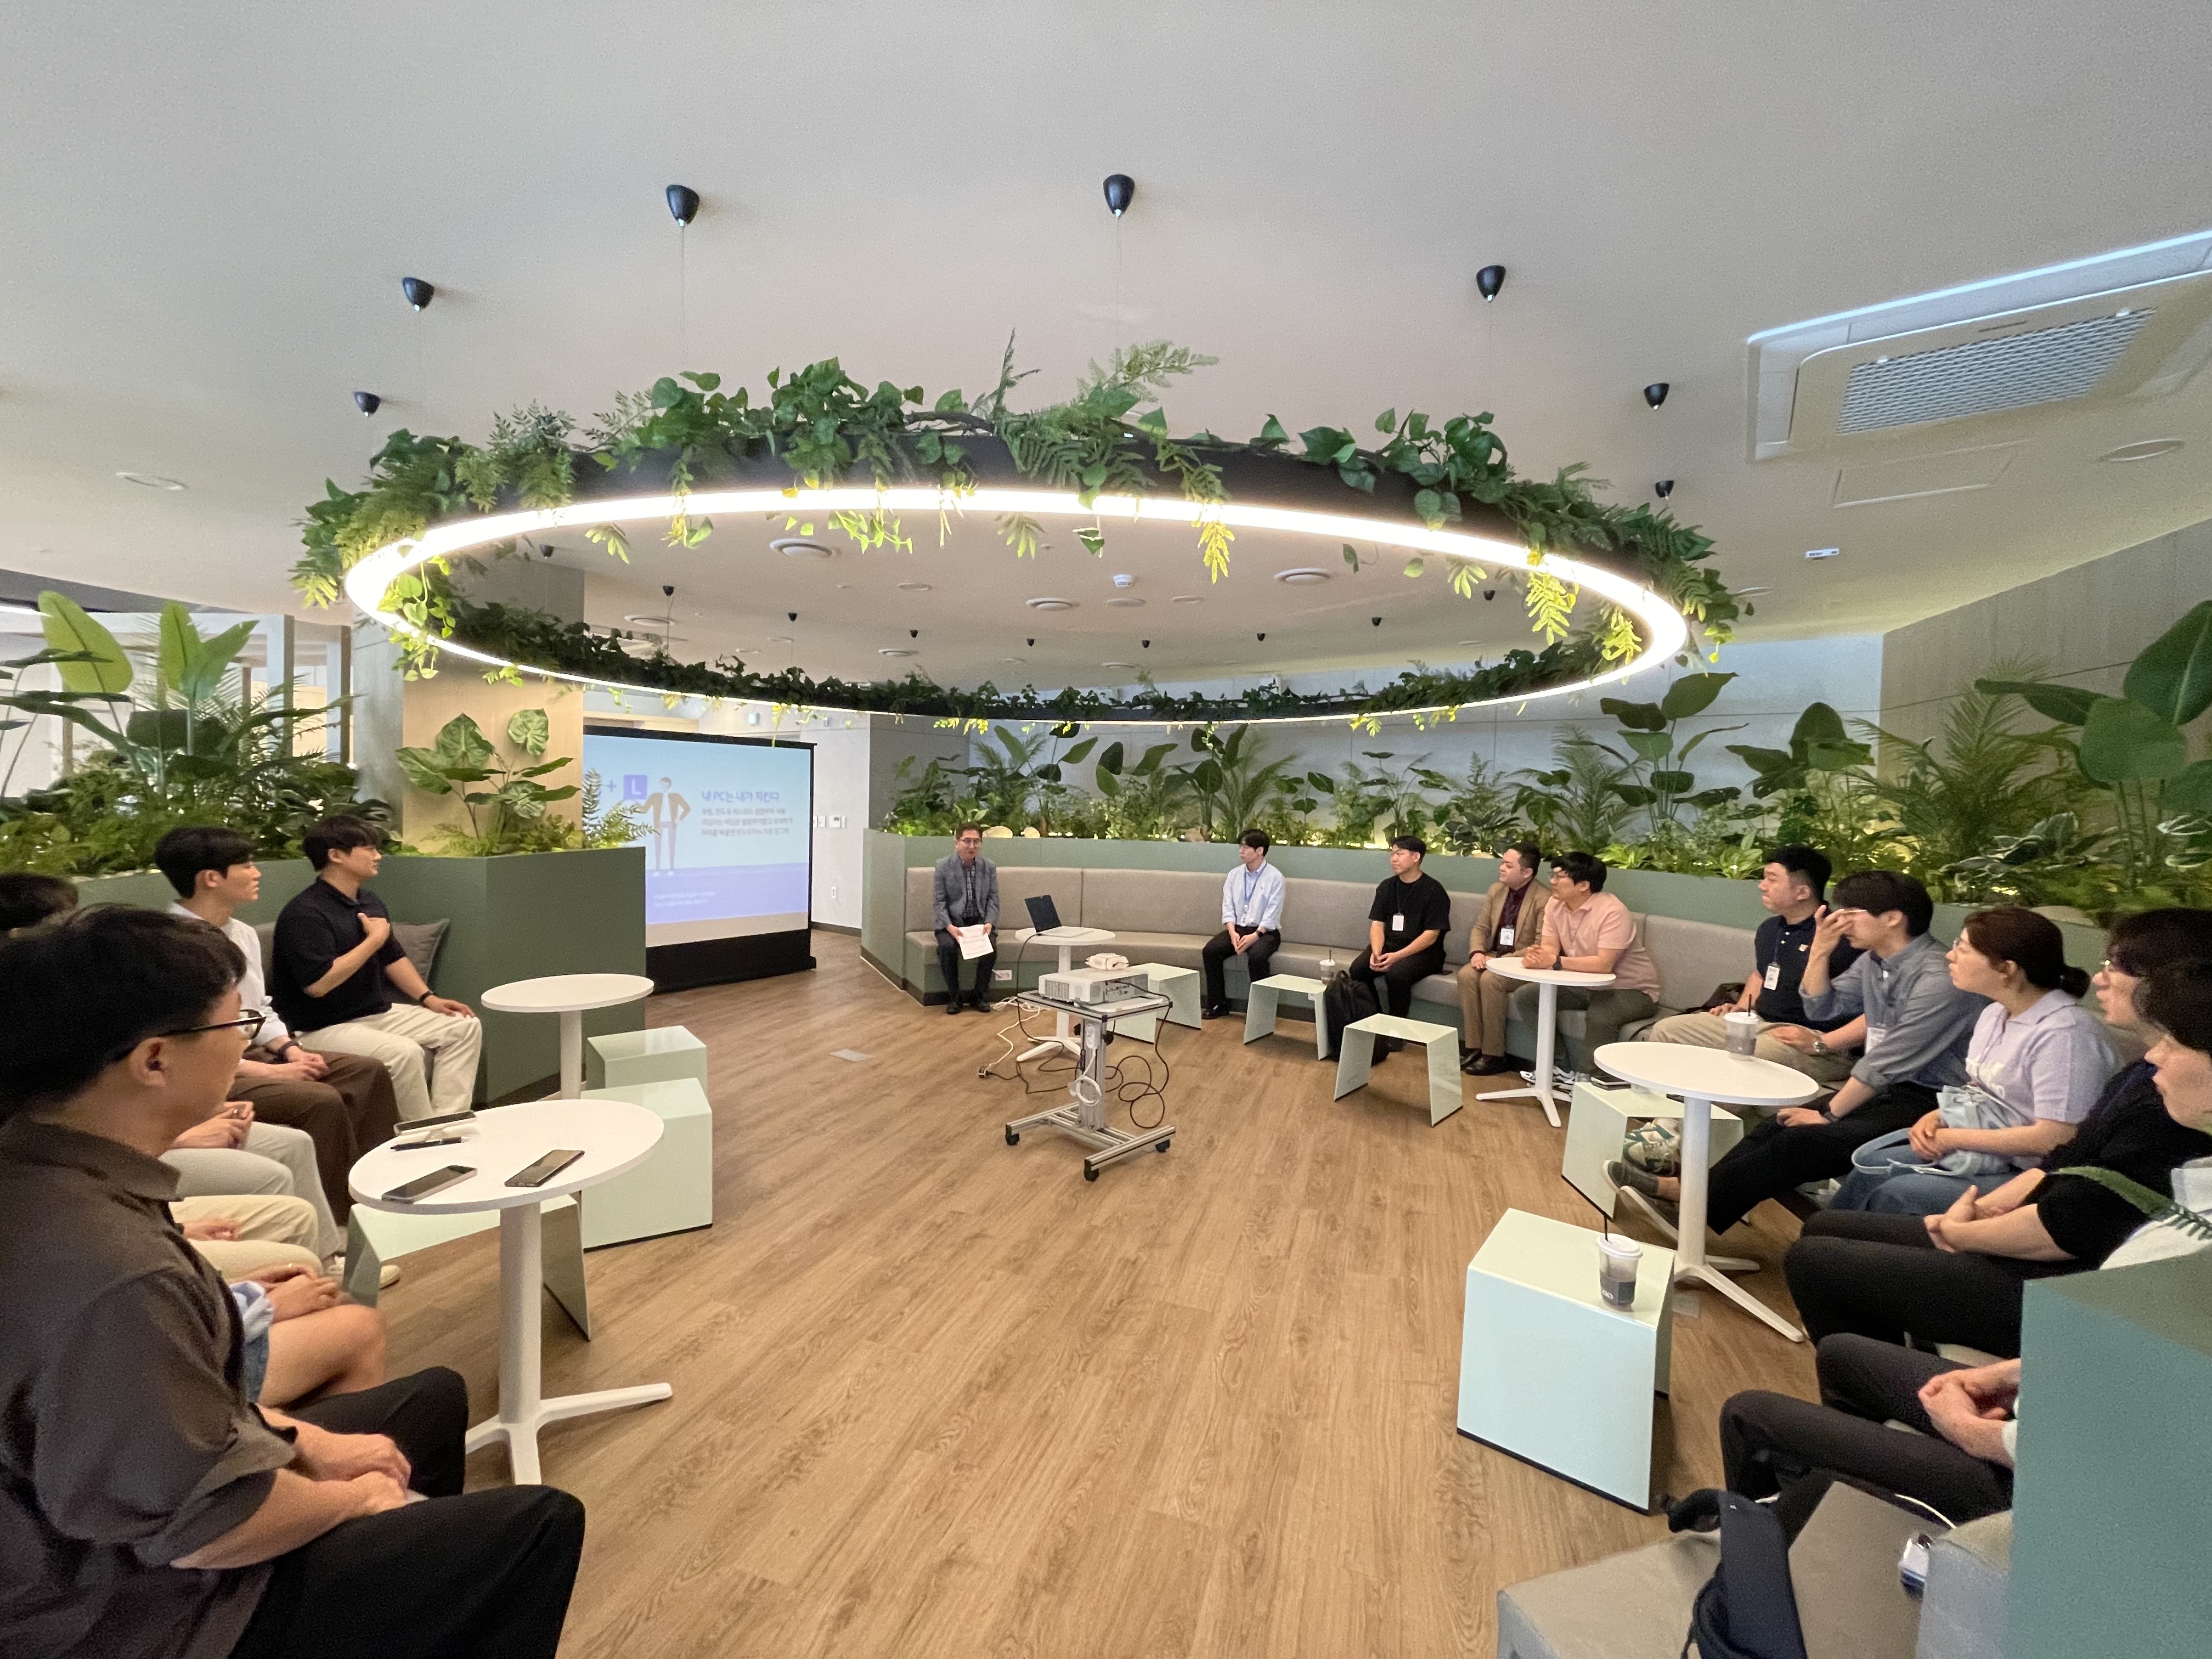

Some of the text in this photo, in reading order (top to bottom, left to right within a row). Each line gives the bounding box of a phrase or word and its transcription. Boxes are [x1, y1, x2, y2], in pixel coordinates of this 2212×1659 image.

[632, 778, 641, 795] L
[702, 791, 779, 803] 내 PC는 내가 지킨다
